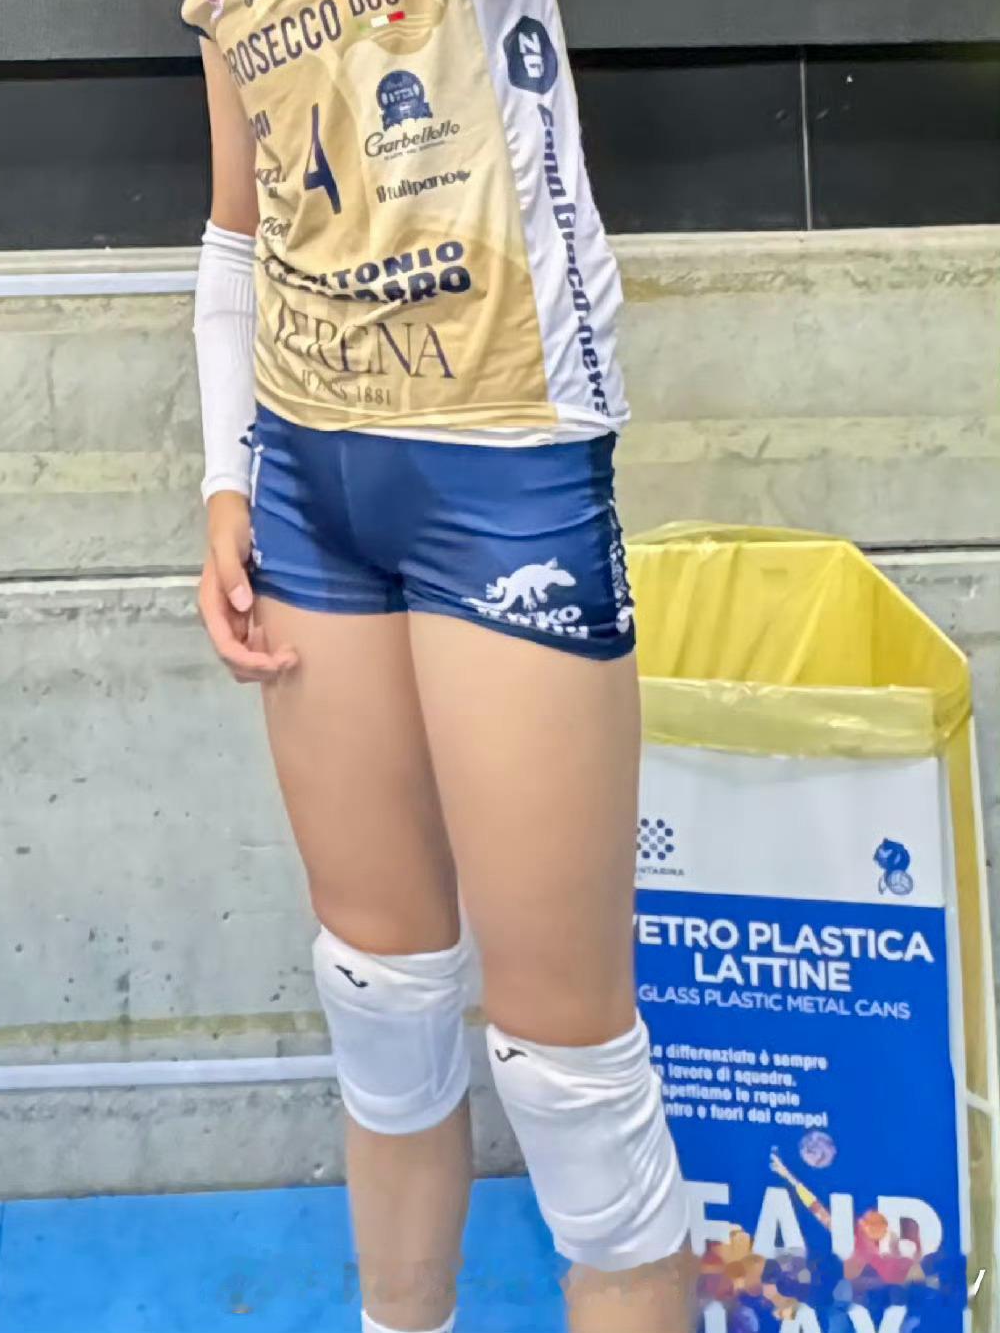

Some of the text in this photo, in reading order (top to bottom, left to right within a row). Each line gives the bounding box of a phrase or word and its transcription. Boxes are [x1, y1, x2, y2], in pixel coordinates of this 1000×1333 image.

[302, 102, 342, 215] 4
[355, 386, 392, 406] 1881
[633, 914, 935, 963] ETRO PLASTICA
[693, 952, 852, 993] LATTINE
[638, 983, 912, 1020] GLASS PLASTIC METAL CANS
[716, 1066, 731, 1082] di
[773, 1053, 828, 1071] sempre
[662, 1083, 801, 1108] spettiamo le regole
[664, 1102, 693, 1118] ntro
[710, 1104, 744, 1122] fuori
